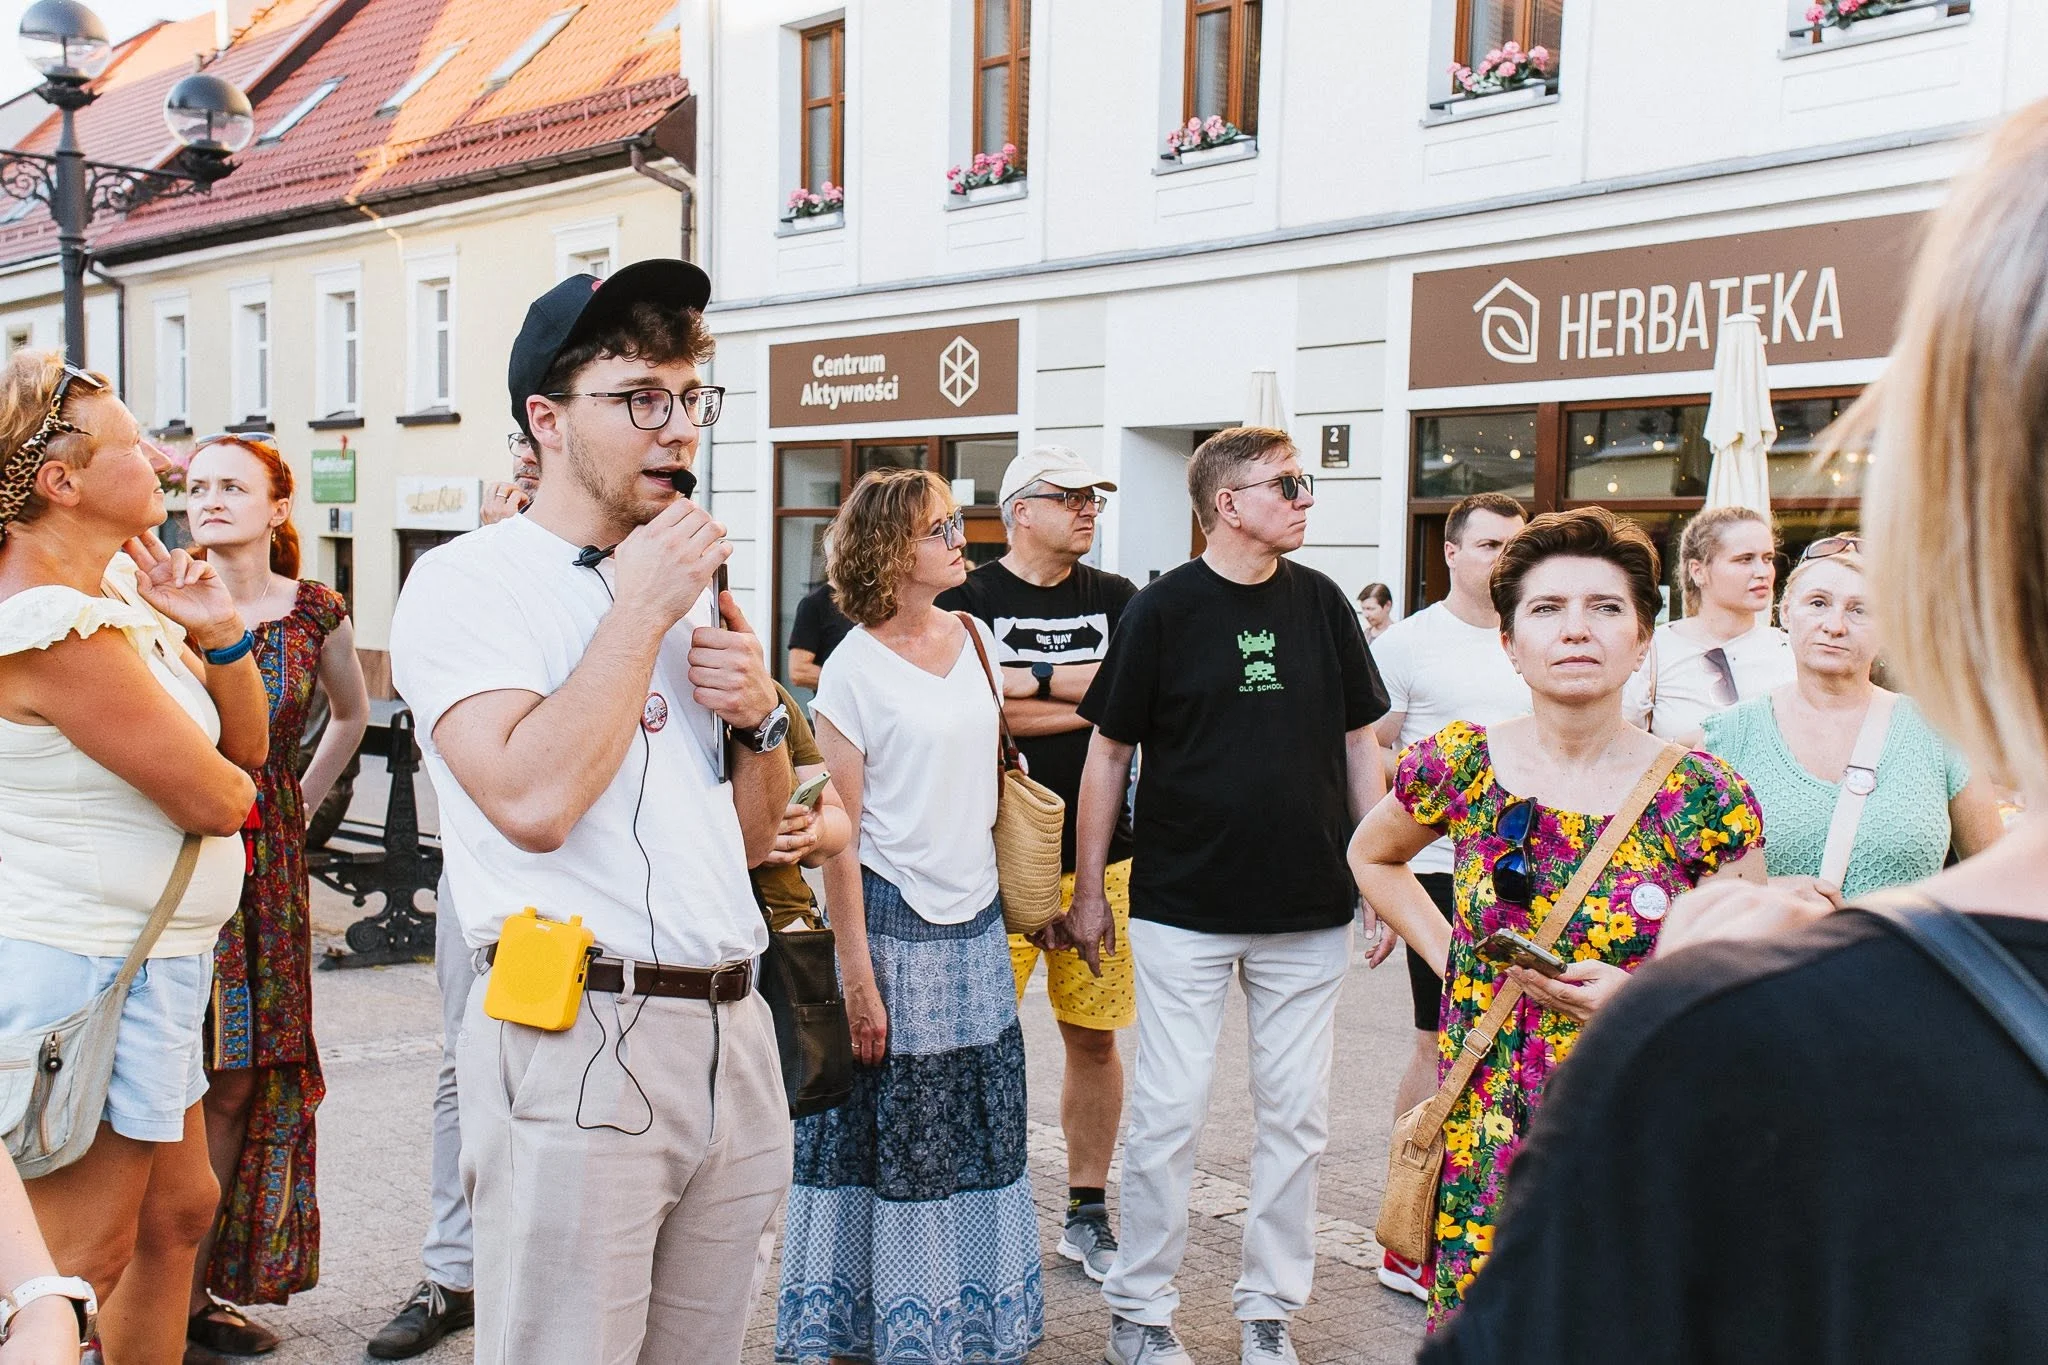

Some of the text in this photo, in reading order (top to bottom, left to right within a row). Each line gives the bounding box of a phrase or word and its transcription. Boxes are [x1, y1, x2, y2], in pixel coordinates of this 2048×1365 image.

[1559, 267, 1843, 360] HERBATEKA
[812, 354, 885, 377] Centrum
[800, 375, 899, 410] Aktywności
[1330, 427, 1339, 442] 2
[1036, 633, 1072, 645] ONE WAY
[1257, 683, 1284, 691] SCHOOL
